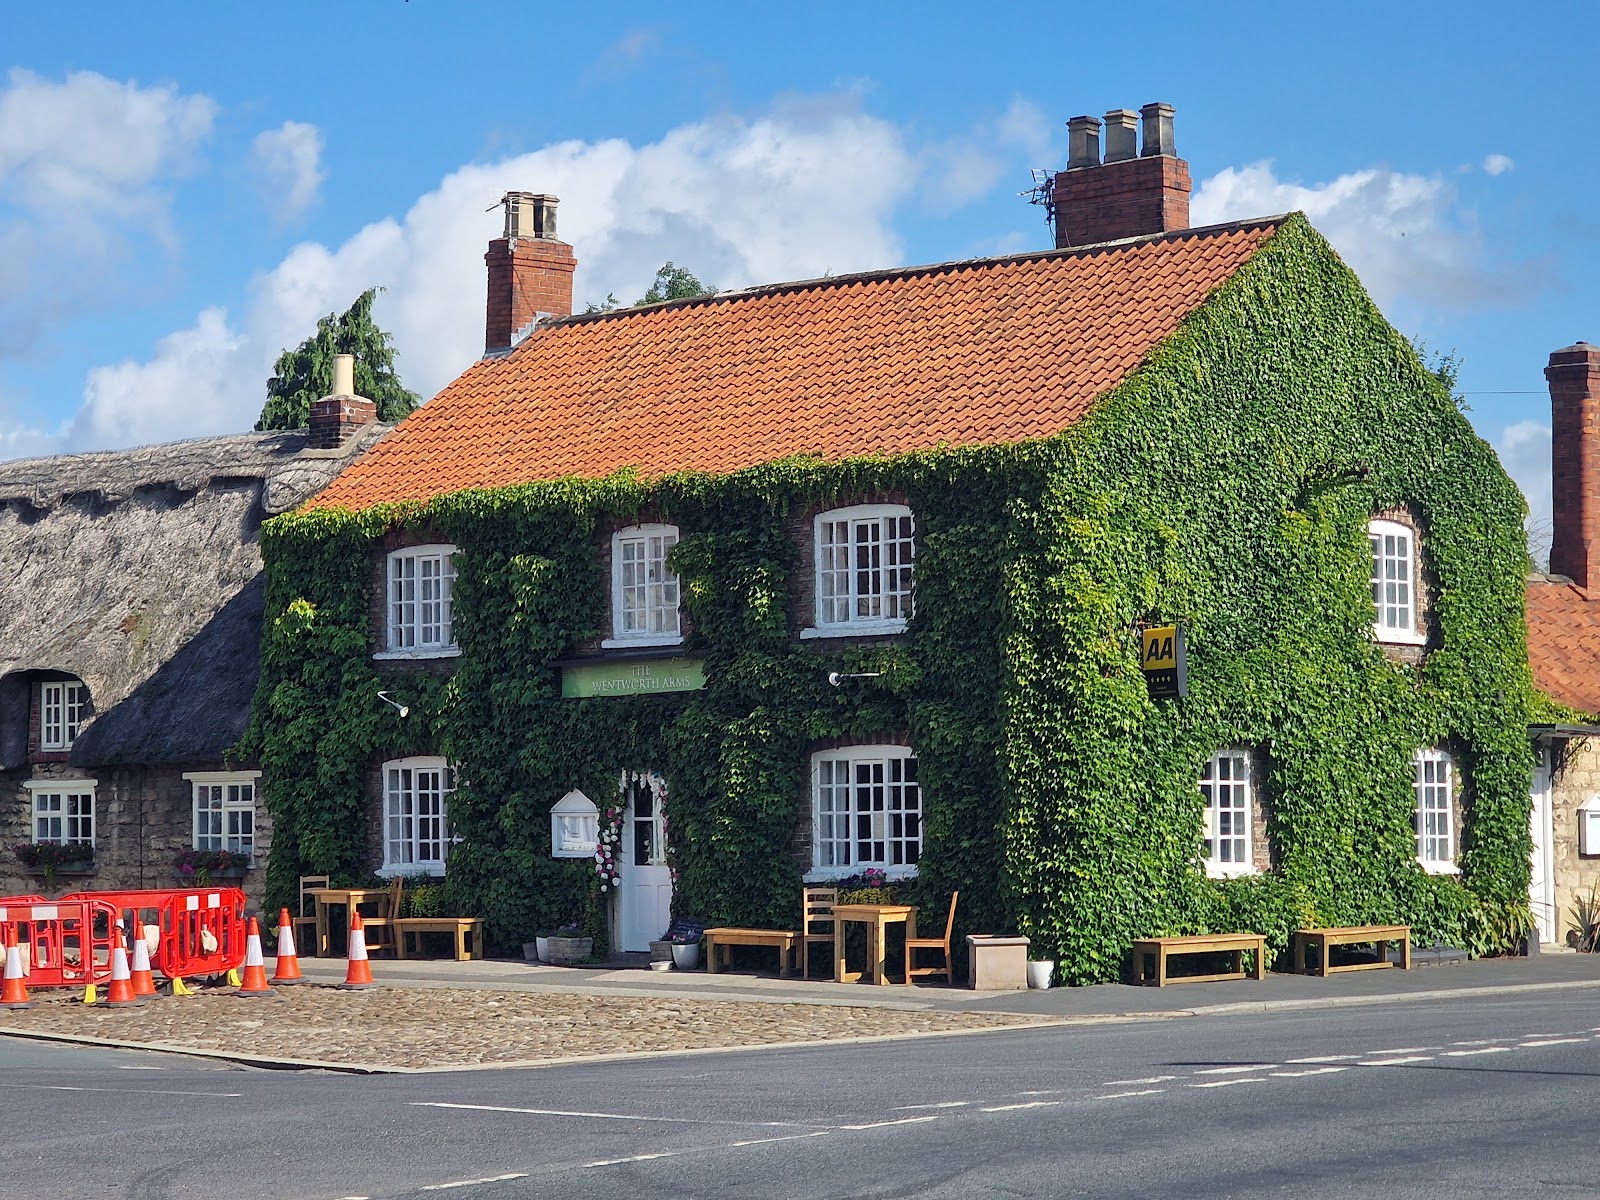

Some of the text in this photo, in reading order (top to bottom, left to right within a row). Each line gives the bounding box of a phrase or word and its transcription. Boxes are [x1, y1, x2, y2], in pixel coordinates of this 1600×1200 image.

[1146, 637, 1173, 662] AA
[630, 665, 651, 676] THE
[592, 676, 690, 691] WENTWORTH ARMS
